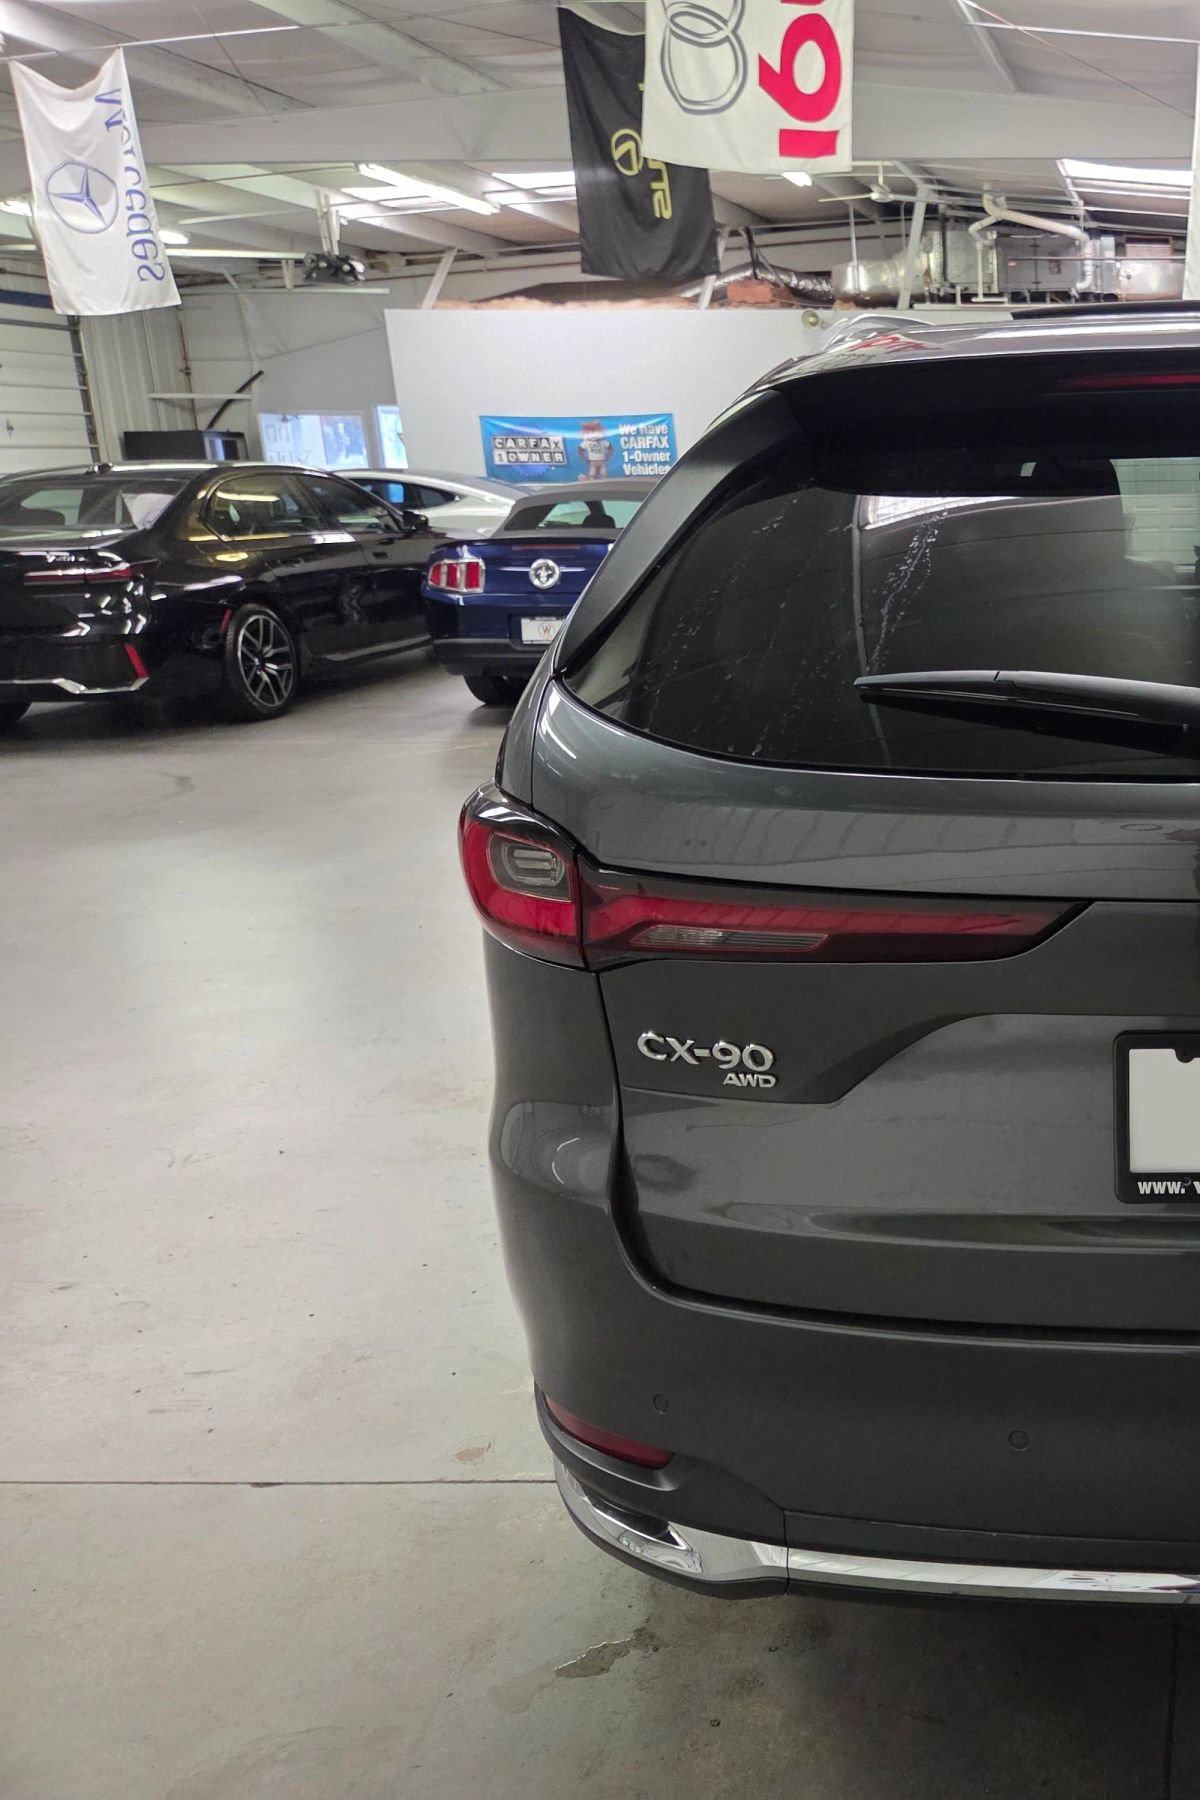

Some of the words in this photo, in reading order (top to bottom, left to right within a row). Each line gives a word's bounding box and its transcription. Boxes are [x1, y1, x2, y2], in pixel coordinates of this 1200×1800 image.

[493, 437, 562, 450] CARFAX
[620, 435, 669, 449] CARFAX
[622, 451, 671, 462] 1-Owner
[637, 1031, 774, 1072] CX-90
[723, 1072, 777, 1088] AWD
